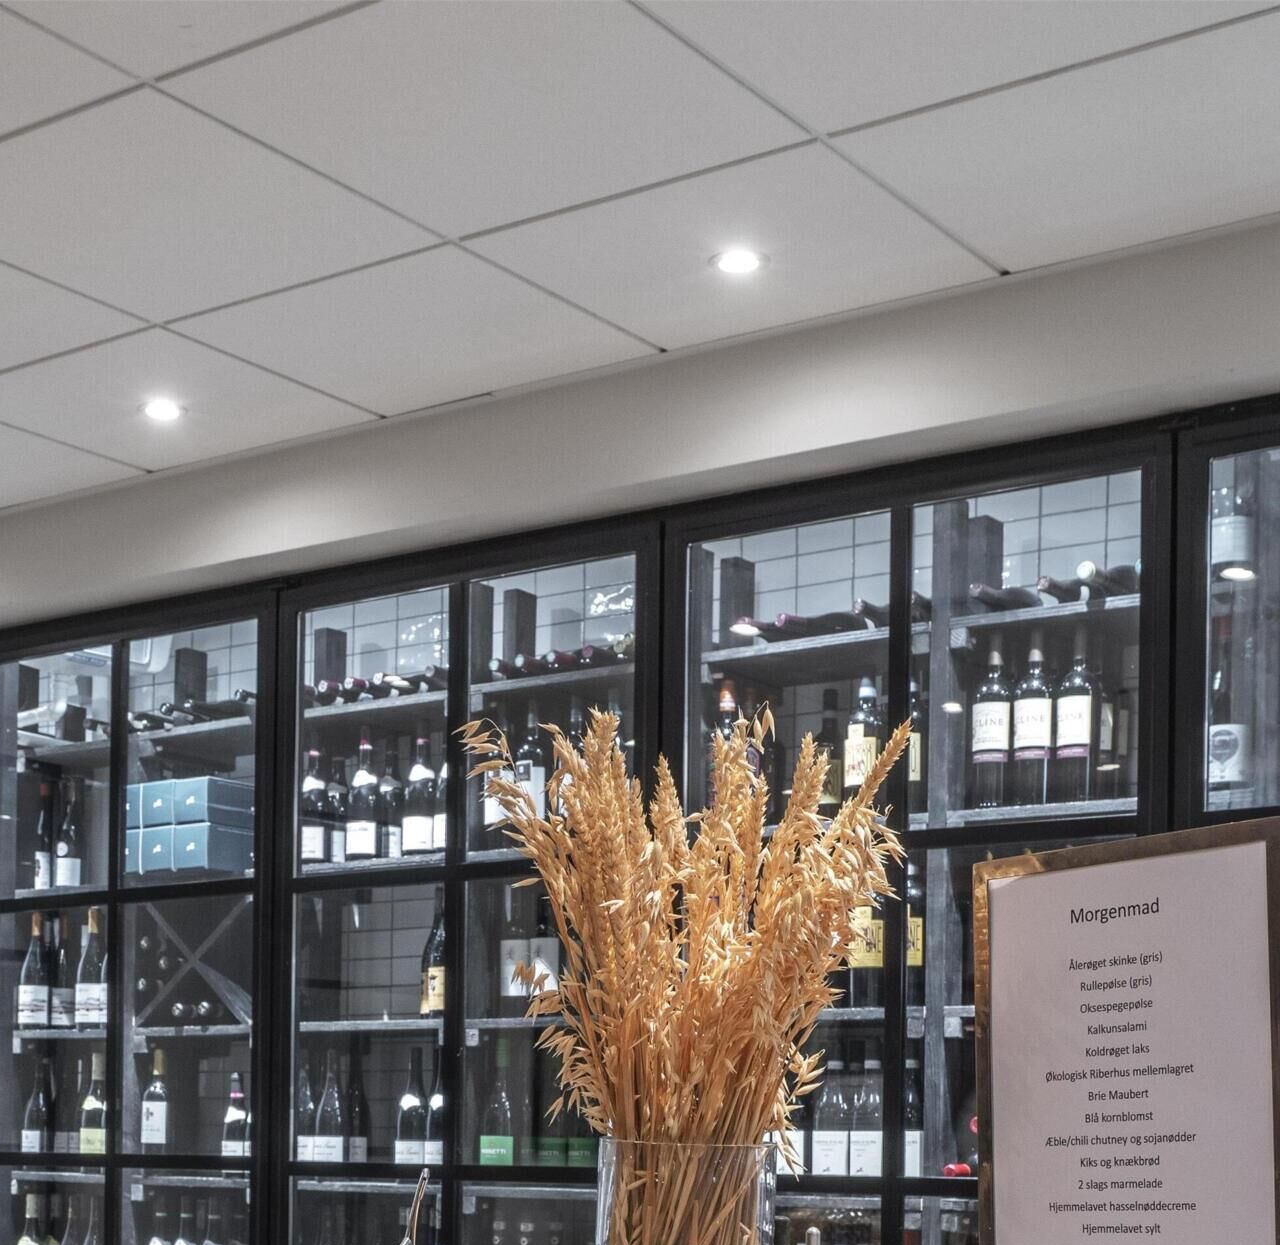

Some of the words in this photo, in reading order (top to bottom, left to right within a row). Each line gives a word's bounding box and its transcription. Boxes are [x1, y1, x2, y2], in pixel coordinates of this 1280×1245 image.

[1071, 897, 1159, 924] Morgenmad
[1109, 955, 1137, 966] skinke
[1140, 951, 1162, 965] (gris)
[1081, 978, 1127, 991] Rullepølse
[1130, 975, 1152, 989] (gris)
[1080, 998, 1152, 1013] Oksespegepølse
[1088, 1021, 1147, 1035] Kalkunsalami
[1086, 1046, 1129, 1057] Koldrøget
[1132, 1043, 1149, 1054] laks
[1046, 1070, 1087, 1083] Økologisk
[1090, 1068, 1130, 1079] Riberhus
[1133, 1064, 1194, 1076] mellemlagret
[1088, 1091, 1106, 1101] Brie
[1109, 1089, 1148, 1100] Maubert
[1085, 1112, 1099, 1123] Blå
[1102, 1112, 1153, 1122] kornblomst
[1045, 1136, 1088, 1147] Æble/chili
[1091, 1135, 1128, 1146] chutney
[1130, 1136, 1142, 1146] og
[1144, 1132, 1196, 1145] sojanødder
[1080, 1157, 1097, 1167] Kiks
[1100, 1160, 1112, 1169] og
[1114, 1155, 1160, 1166] knækbrød
[1078, 1180, 1083, 1189] 2
[1086, 1179, 1108, 1191] slags
[1111, 1178, 1163, 1188] marmelade
[1049, 1202, 1107, 1213] Hjemmelavet
[1110, 1201, 1196, 1211] hasselnøddecreme
[1083, 1224, 1143, 1235] Hjemmelavet
[1145, 1224, 1160, 1235] sylt
